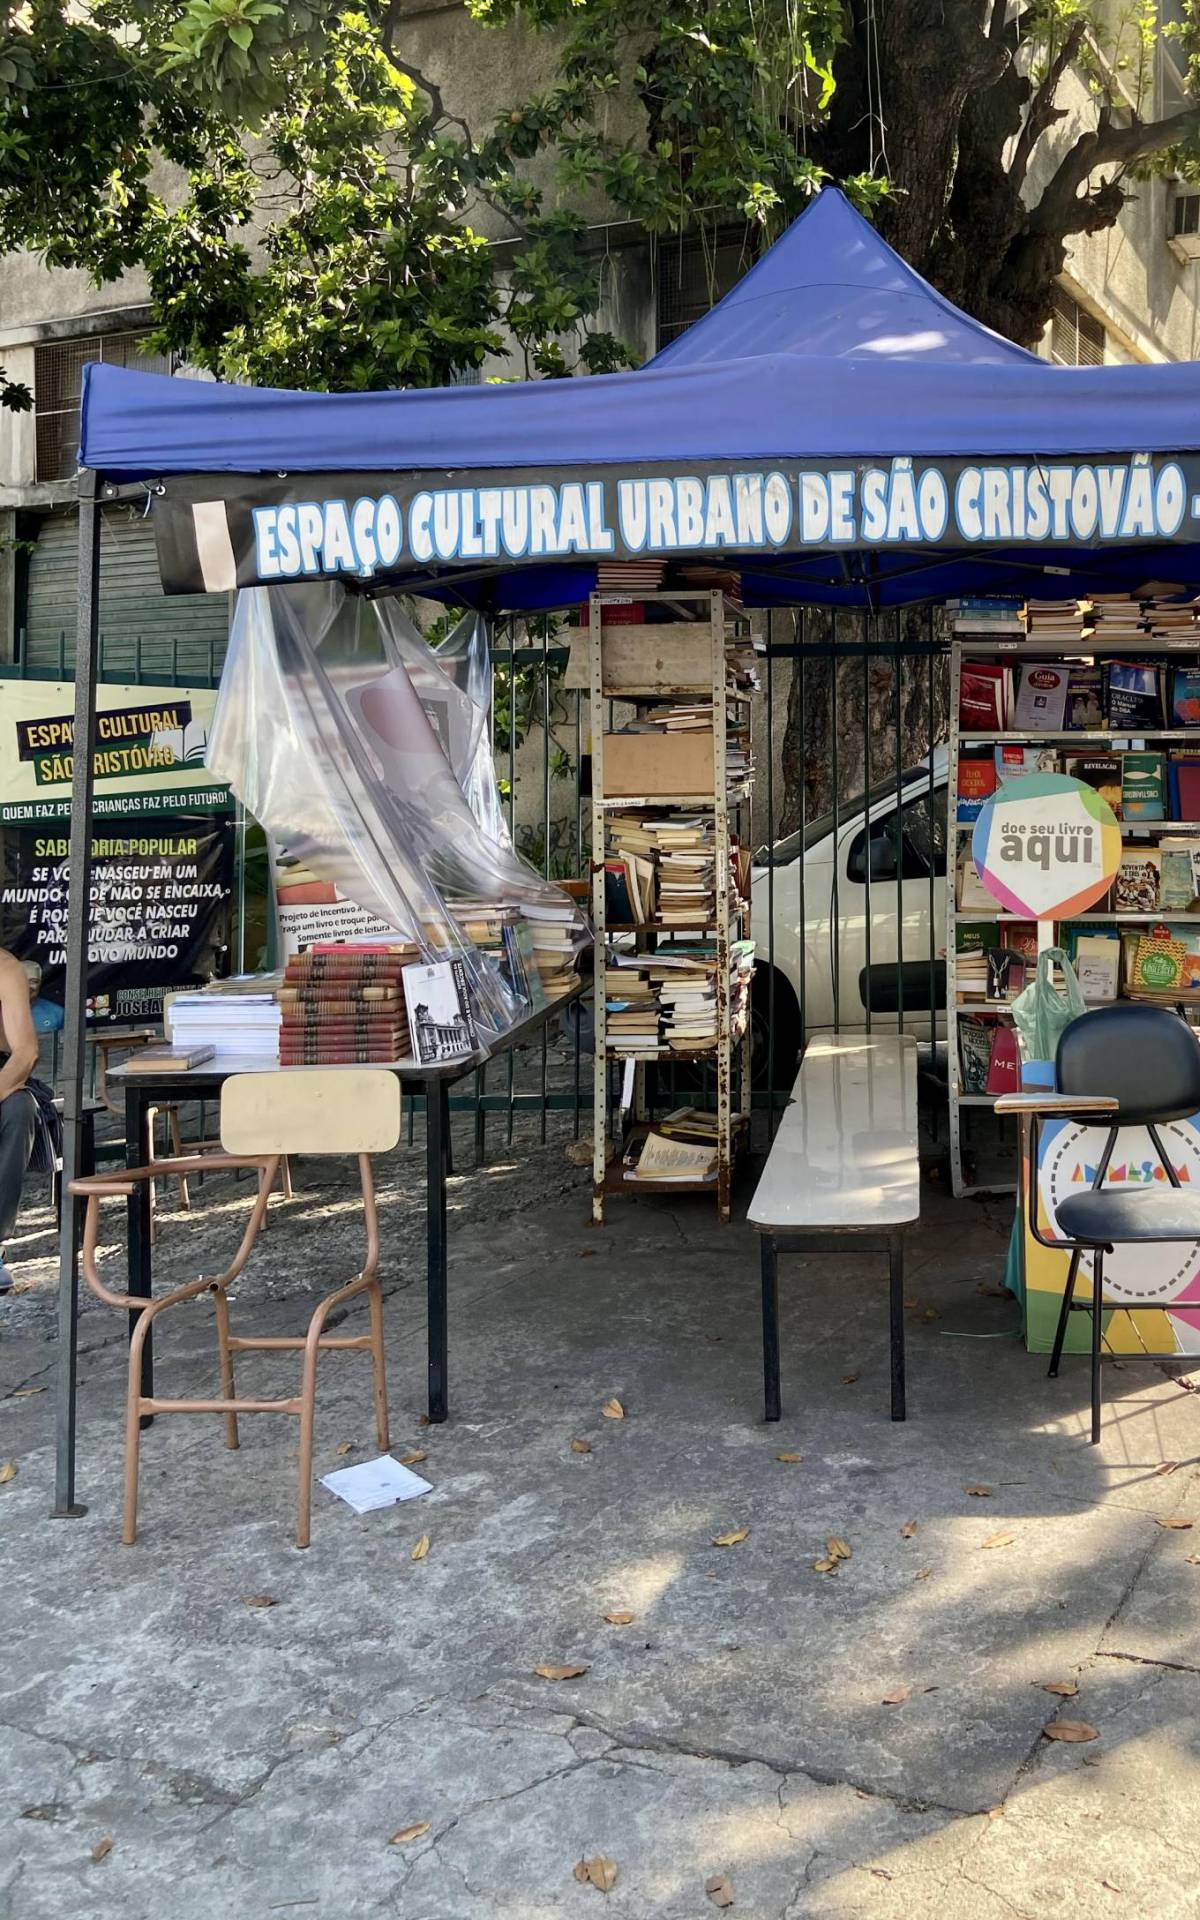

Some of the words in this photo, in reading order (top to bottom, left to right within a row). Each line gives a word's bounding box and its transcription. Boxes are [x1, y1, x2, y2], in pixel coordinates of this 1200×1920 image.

[251, 494, 402, 577] ESPAÇO
[408, 481, 615, 562] CULTURAL
[616, 471, 790, 552] URBANO
[799, 470, 856, 544] DE
[860, 456, 949, 543] SÃO
[955, 452, 1188, 542] CRISTOVÃO
[27, 720, 76, 748] ESPA
[99, 709, 183, 739] CULTURAL
[93, 743, 176, 775] RISTÓVÃO
[3, 806, 33, 820] QUEM
[35, 804, 56, 818] FAZ
[92, 797, 141, 816] CRIANÇAS
[143, 795, 162, 810] FAZ
[163, 793, 187, 808] PELO
[188, 791, 228, 806] FUTURO!
[1001, 822, 1026, 834] doe
[1030, 825, 1055, 834] seu
[1059, 822, 1094, 836] livro
[129, 838, 197, 856] POPULAR
[1000, 834, 1093, 871] aqui
[32, 867, 49, 881] SE
[153, 865, 172, 879] EM
[176, 865, 197, 879] UM
[2, 888, 62, 903] MUNDO
[110, 884, 143, 900] NÃO
[146, 886, 162, 899] SE
[30, 905, 38, 924] É
[105, 903, 142, 921] VOCÊ
[146, 904, 198, 919] NASCEU
[279, 912, 308, 923] Projeto
[310, 910, 319, 918] de
[320, 906, 356, 916] Incentivo
[316, 920, 333, 929] livro
[340, 915, 366, 927] troque
[367, 914, 379, 923] po
[135, 925, 147, 939] A
[151, 924, 190, 939] CRIAR
[297, 930, 332, 942] Somente
[333, 928, 353, 937] livros
[364, 924, 390, 933] leitura
[88, 946, 119, 963] OVO
[124, 944, 178, 962] MUNDO
